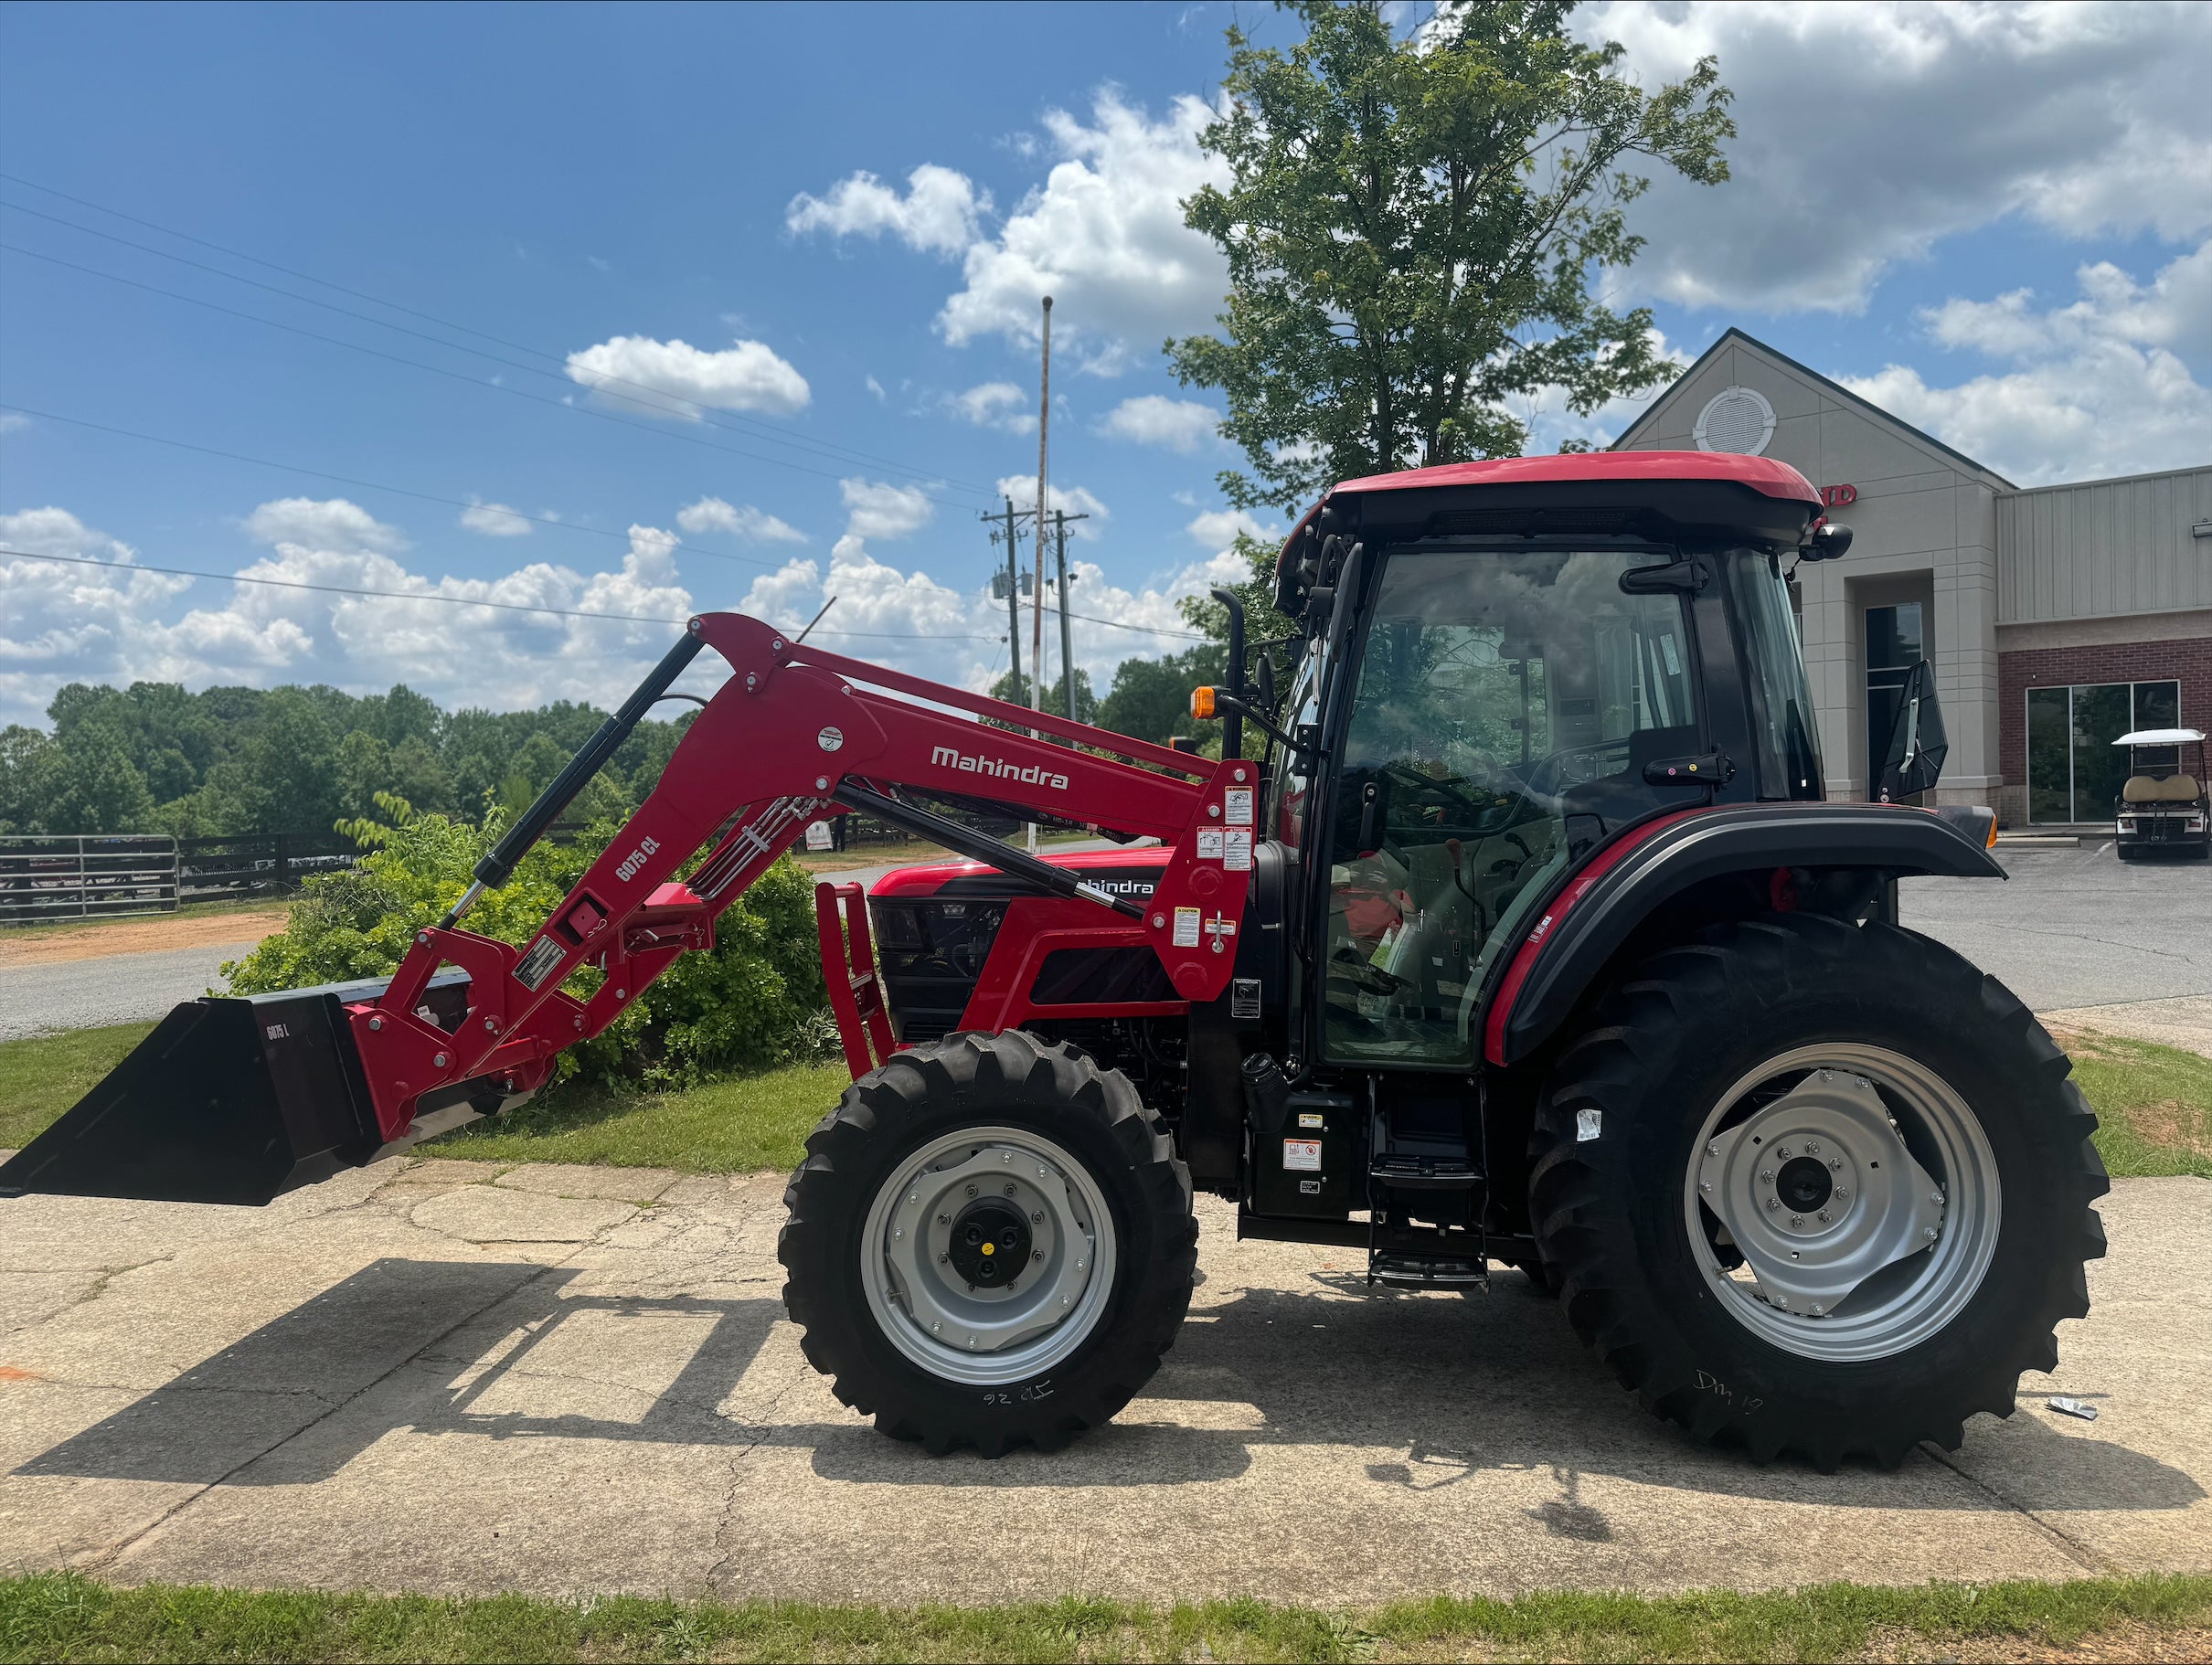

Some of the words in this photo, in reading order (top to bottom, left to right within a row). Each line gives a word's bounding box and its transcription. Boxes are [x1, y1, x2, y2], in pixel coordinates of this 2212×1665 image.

[931, 746, 1069, 790] Mahindra
[615, 849, 648, 883] 6075
[640, 835, 661, 855] CL
[1083, 879, 1154, 895] hindra
[266, 1024, 284, 1040] 6075
[283, 1023, 290, 1036] L
